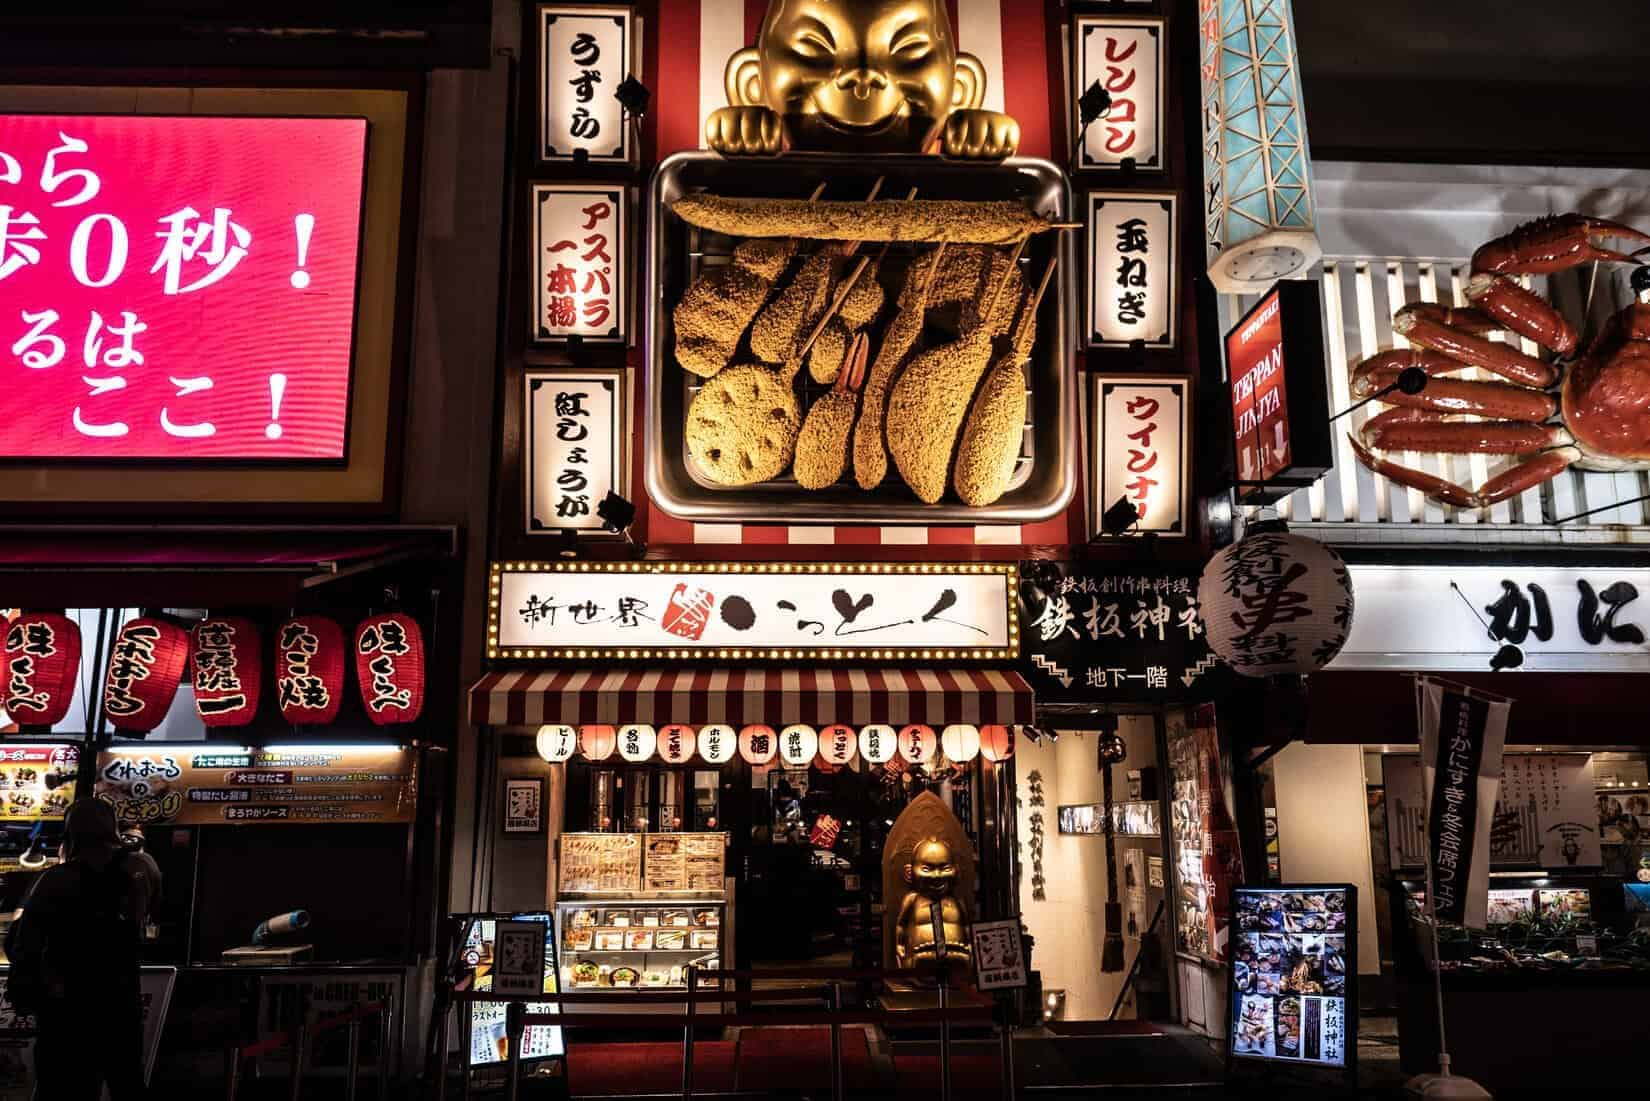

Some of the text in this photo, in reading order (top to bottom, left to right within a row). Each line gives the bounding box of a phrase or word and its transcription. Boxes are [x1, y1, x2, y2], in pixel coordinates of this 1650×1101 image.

[569, 33, 602, 139] うずら
[1104, 37, 1137, 154] レンコン
[546, 239, 578, 328] 一本揚
[581, 202, 612, 328] アスパラ
[1116, 218, 1149, 325] 玉ねぎ
[1232, 341, 1282, 407] TEPPAN
[555, 392, 590, 518] 紅しょうが
[518, 594, 657, 629] 新世界
[1485, 578, 1647, 645] かに
[279, 622, 330, 712] たこ焼
[1084, 665, 1168, 689] 地下一階
[556, 727, 570, 757] ビール
[750, 733, 769, 755] 酒
